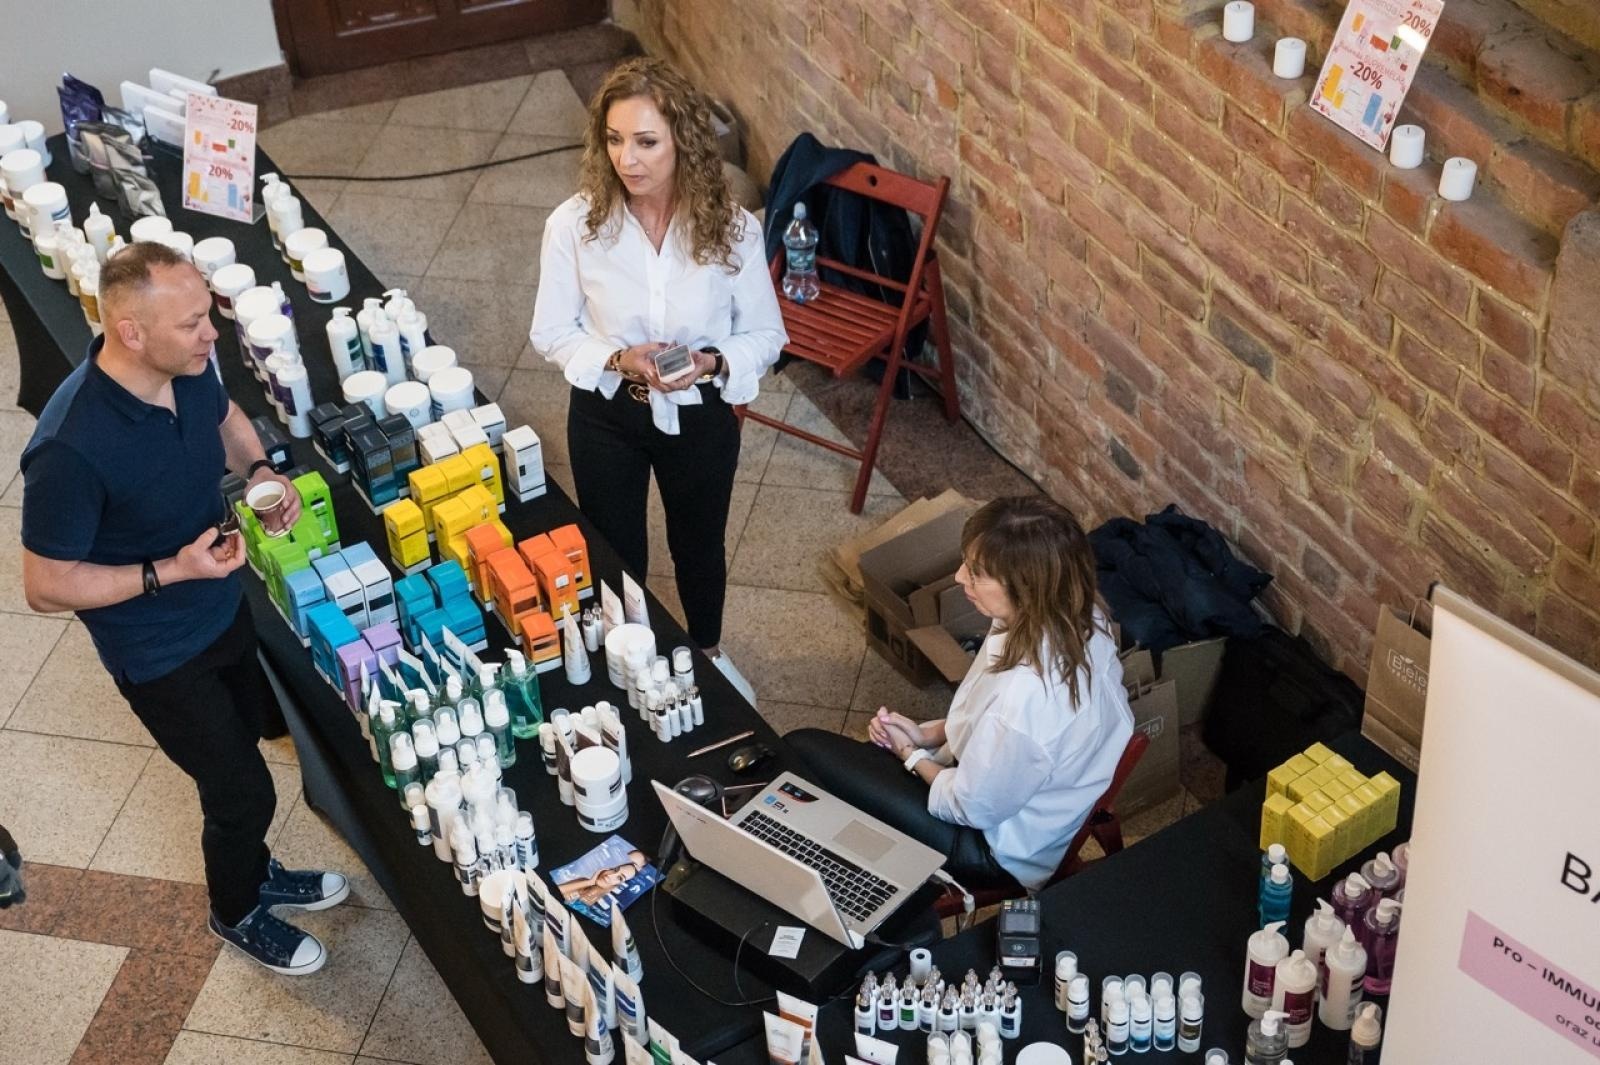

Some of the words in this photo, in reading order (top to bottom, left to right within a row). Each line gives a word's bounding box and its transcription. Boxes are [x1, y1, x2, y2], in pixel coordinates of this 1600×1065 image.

[1399, 10, 1431, 38] -20%
[1350, 61, 1383, 90] -20%
[226, 118, 255, 134] -20%
[1493, 936, 1523, 963] Pro
[1555, 1014, 1589, 1038] oraz
